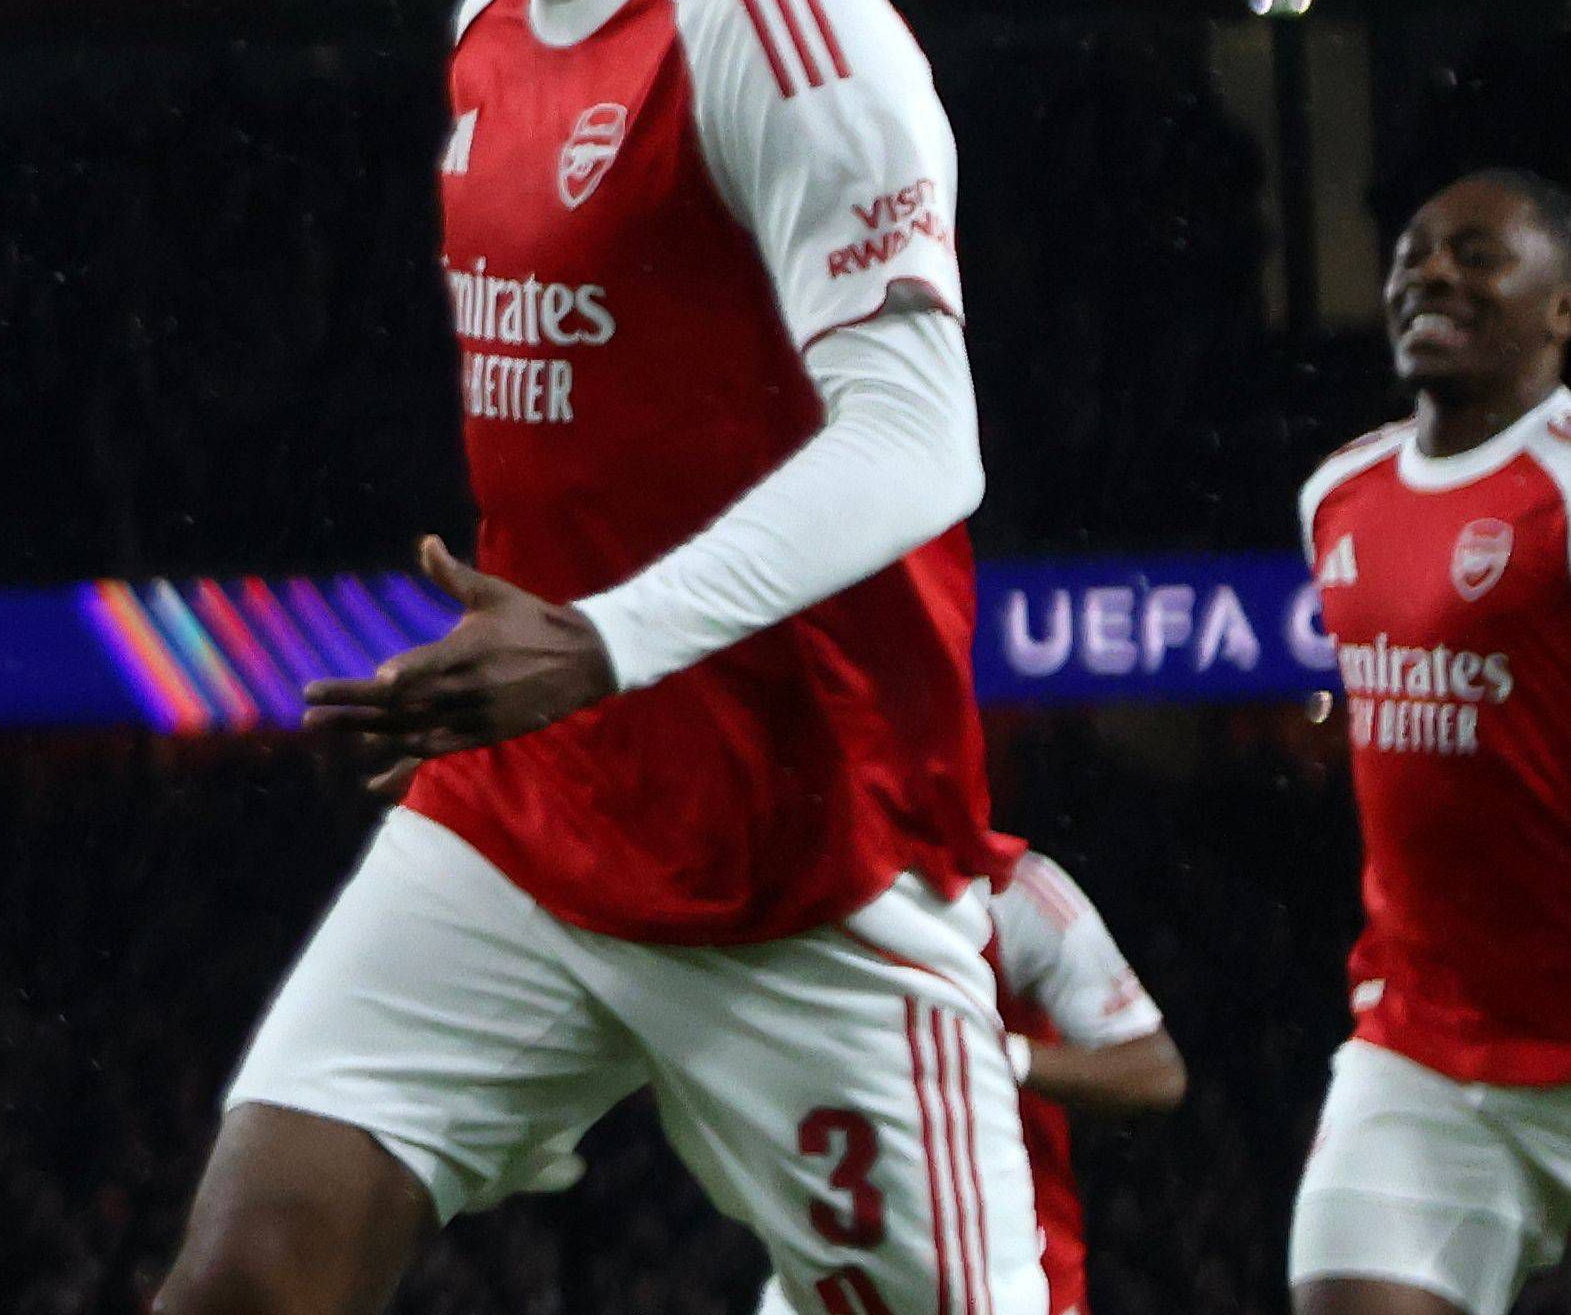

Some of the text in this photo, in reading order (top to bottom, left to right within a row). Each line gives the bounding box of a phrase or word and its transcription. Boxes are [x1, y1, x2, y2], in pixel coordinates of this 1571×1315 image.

[442, 255, 616, 347] mirates
[1002, 584, 1263, 677] UEFA
[1333, 632, 1514, 704] mirates
[798, 1108, 885, 1249] 3
